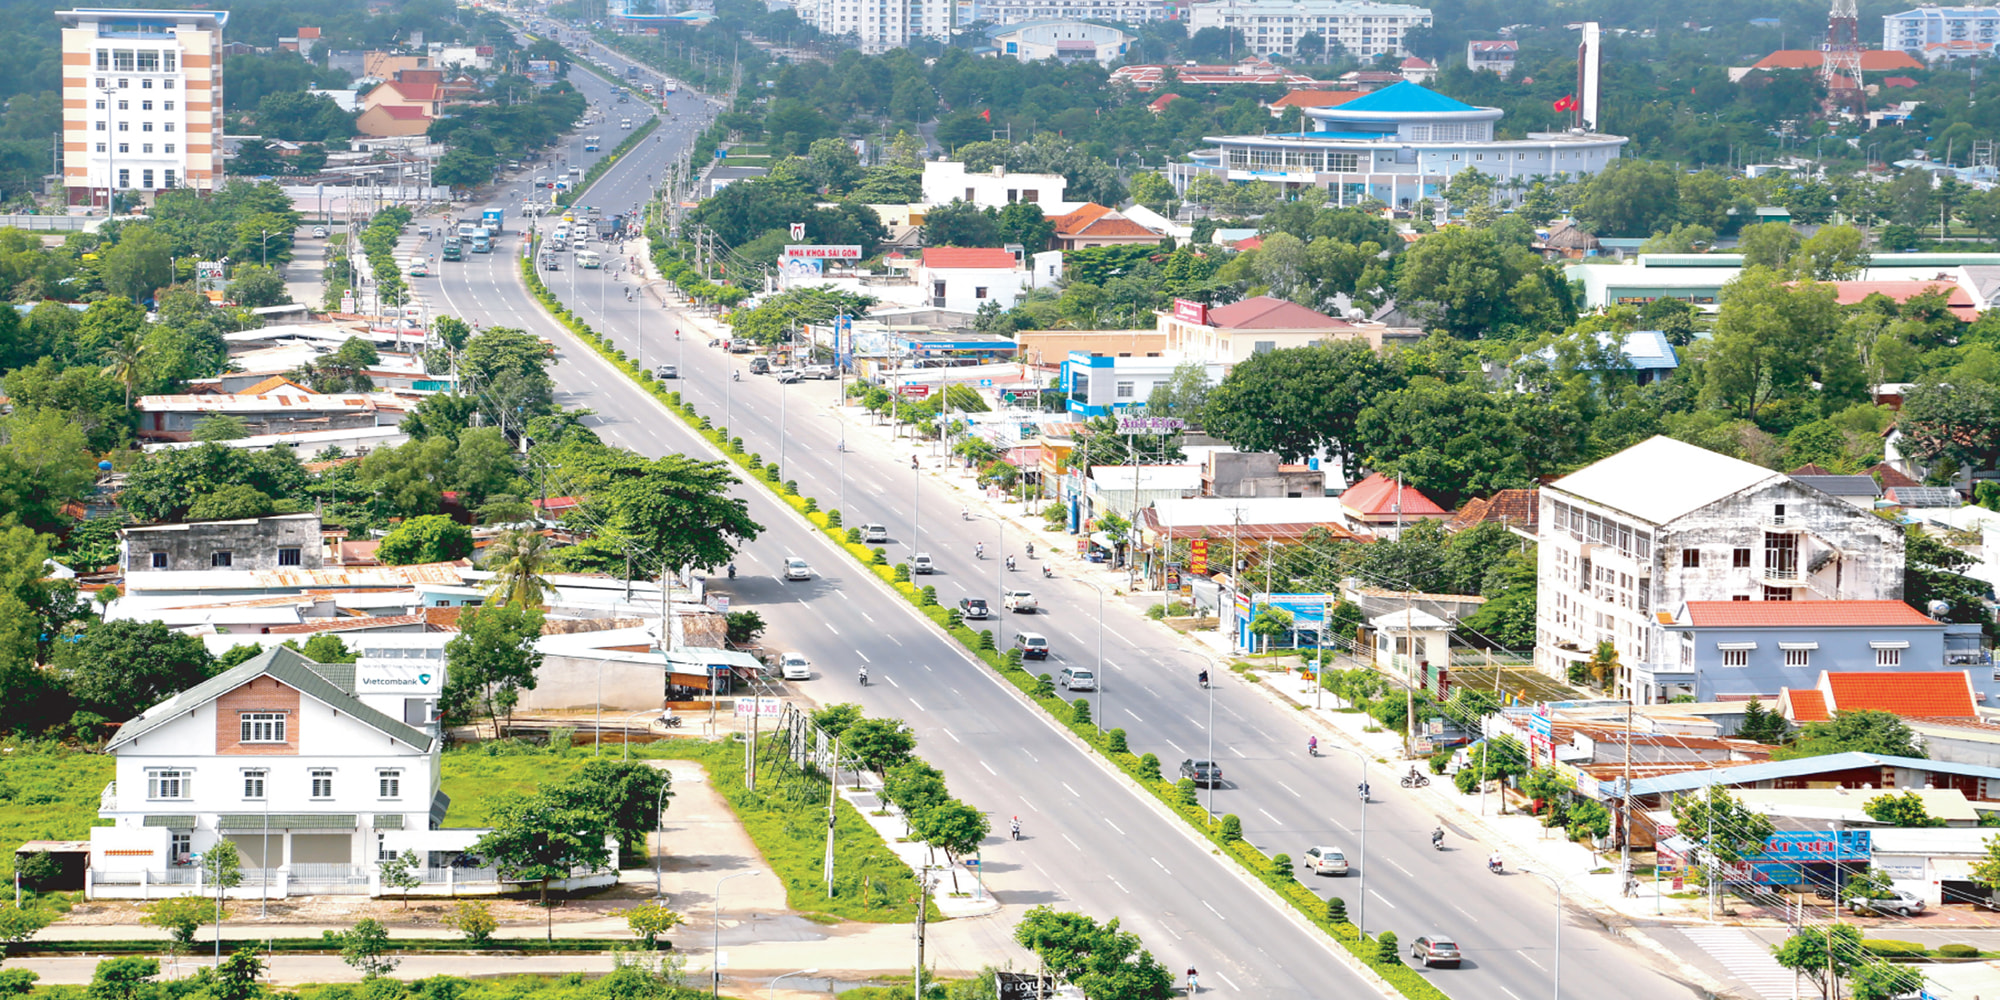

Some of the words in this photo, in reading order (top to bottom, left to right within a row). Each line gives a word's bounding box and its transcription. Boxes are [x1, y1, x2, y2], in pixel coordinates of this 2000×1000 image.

[788, 249, 804, 257] NHA
[806, 249, 826, 257] KHOA
[1120, 417, 1148, 428] Anh
[1151, 417, 1184, 428] Khoa
[362, 677, 418, 686] Vietcombank
[764, 704, 778, 713] XE
[1761, 839, 1792, 853] ẤT
